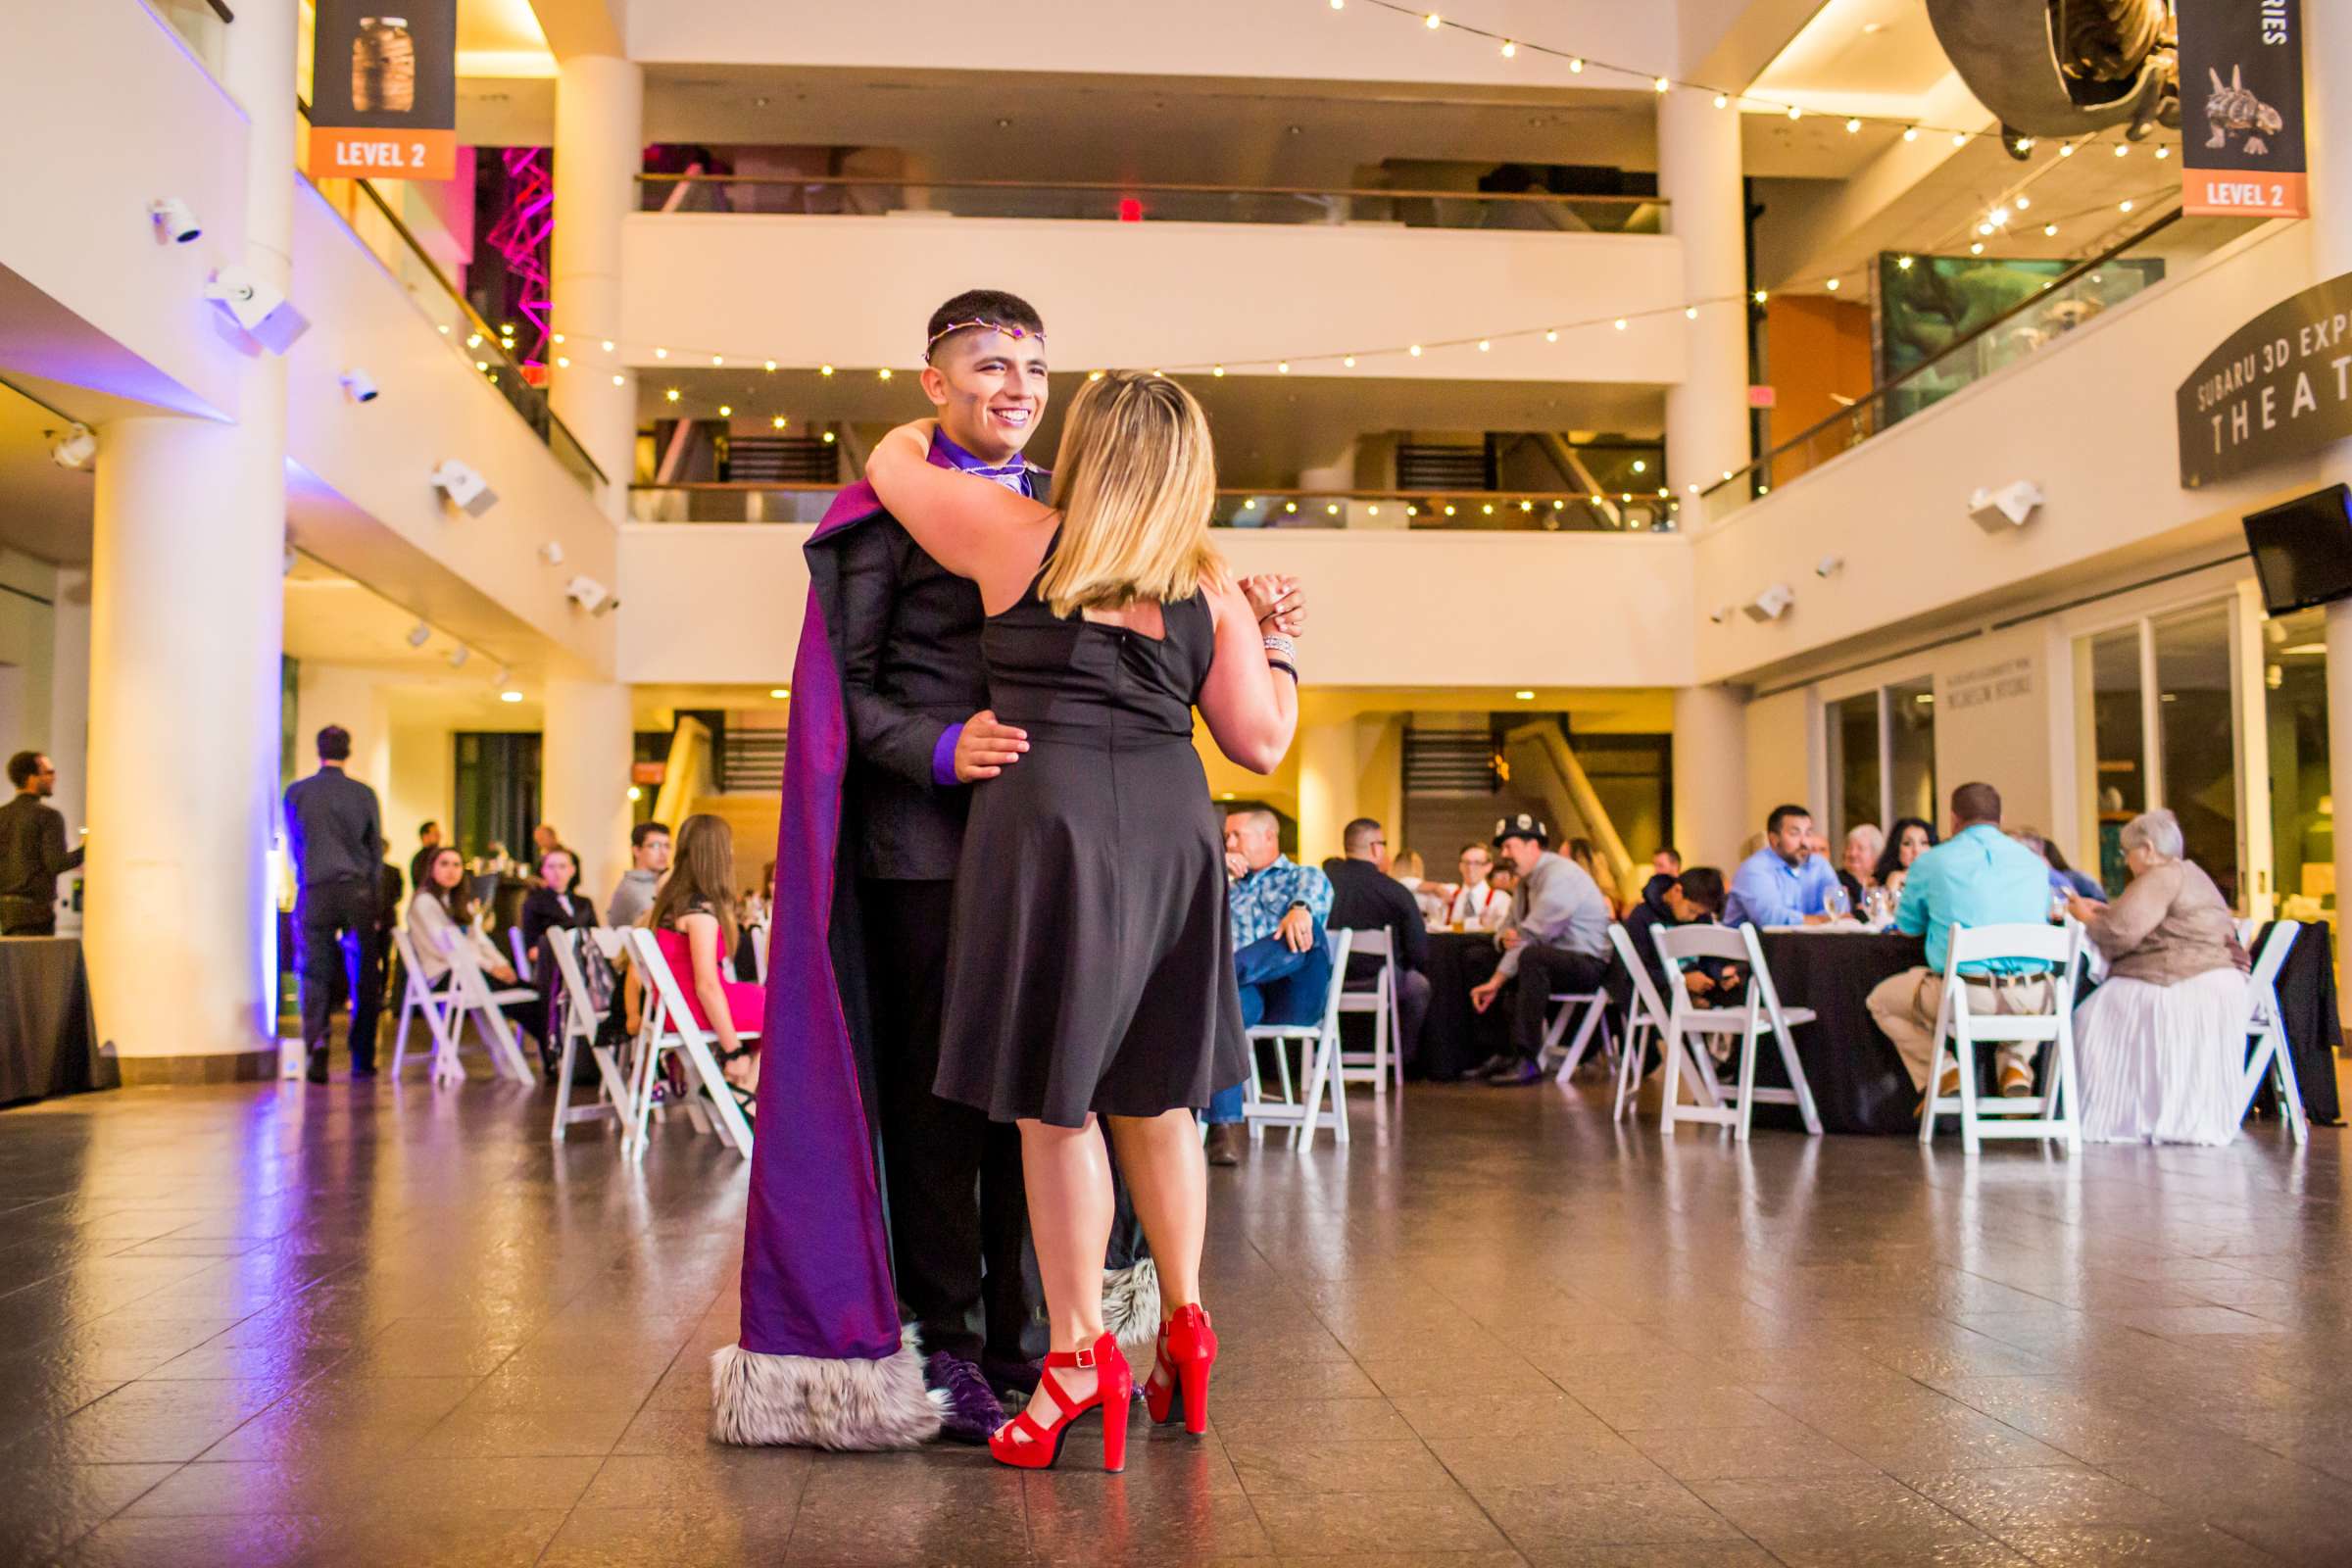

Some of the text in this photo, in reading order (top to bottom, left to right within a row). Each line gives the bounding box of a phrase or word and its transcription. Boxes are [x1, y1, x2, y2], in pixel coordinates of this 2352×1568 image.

[335, 141, 426, 168] LEVEL 2
[2207, 182, 2284, 207] LEVEL 2
[2197, 310, 2352, 413] SUBARU 3D EXP
